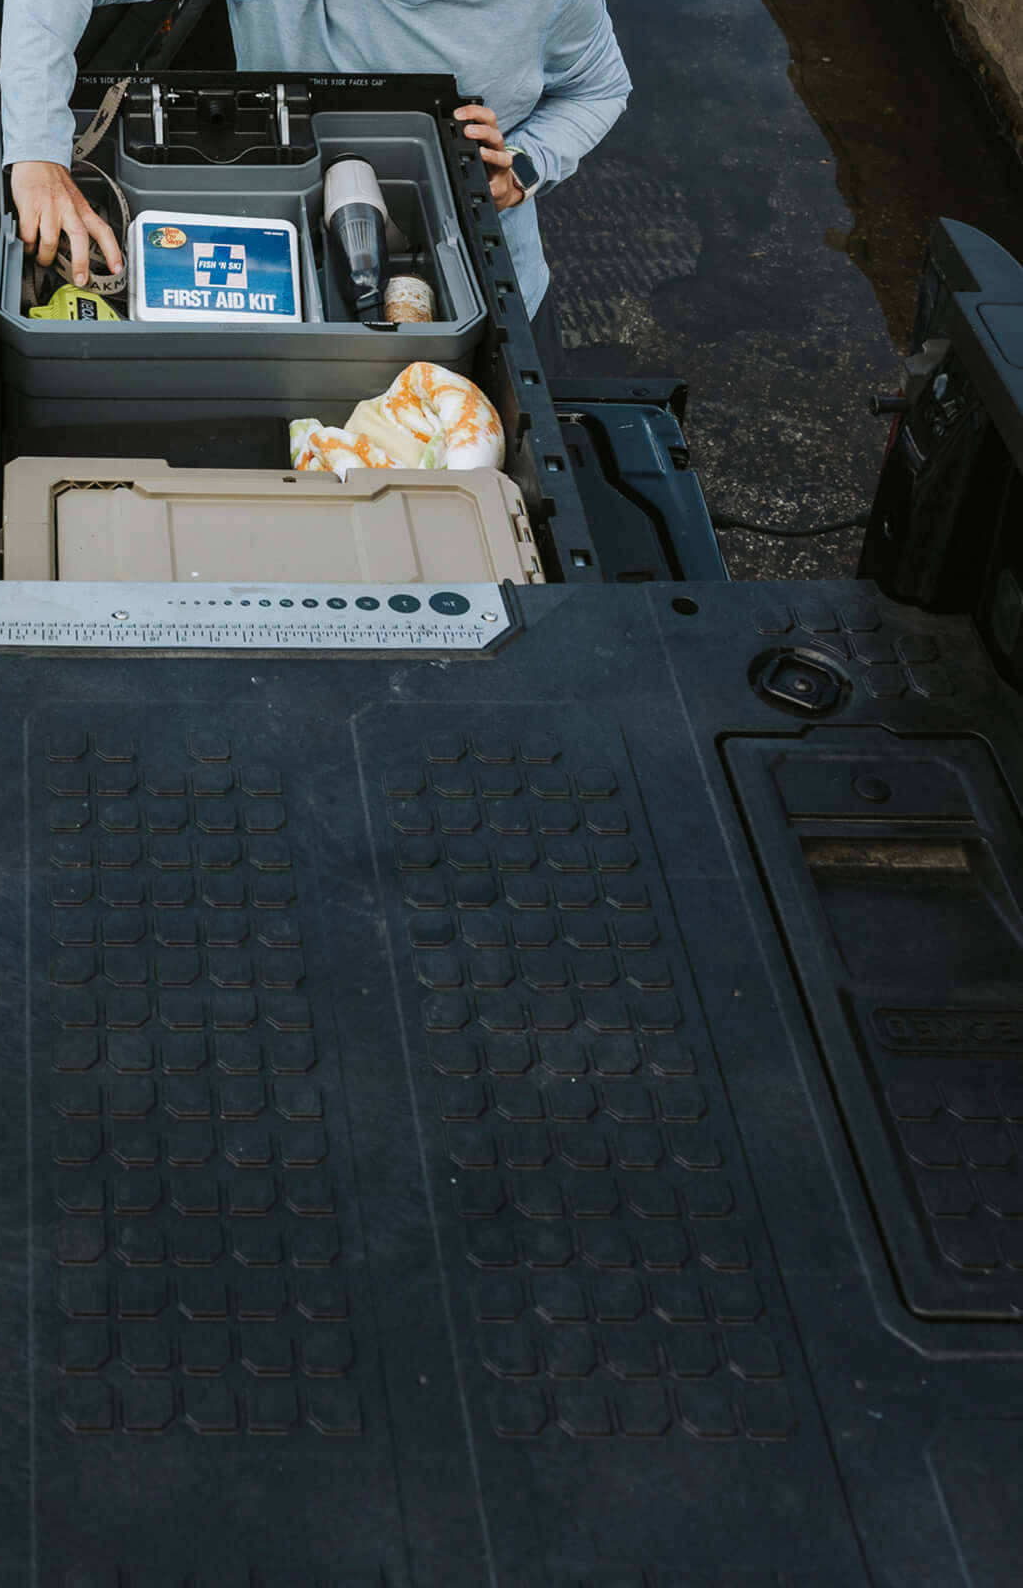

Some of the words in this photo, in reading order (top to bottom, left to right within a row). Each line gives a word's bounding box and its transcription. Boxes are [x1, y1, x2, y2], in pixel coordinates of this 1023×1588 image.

[198, 260, 217, 269] FISH
[228, 262, 242, 270] SKI
[163, 288, 212, 307] FIRST
[215, 290, 246, 309] AID
[249, 293, 277, 312] KIT
